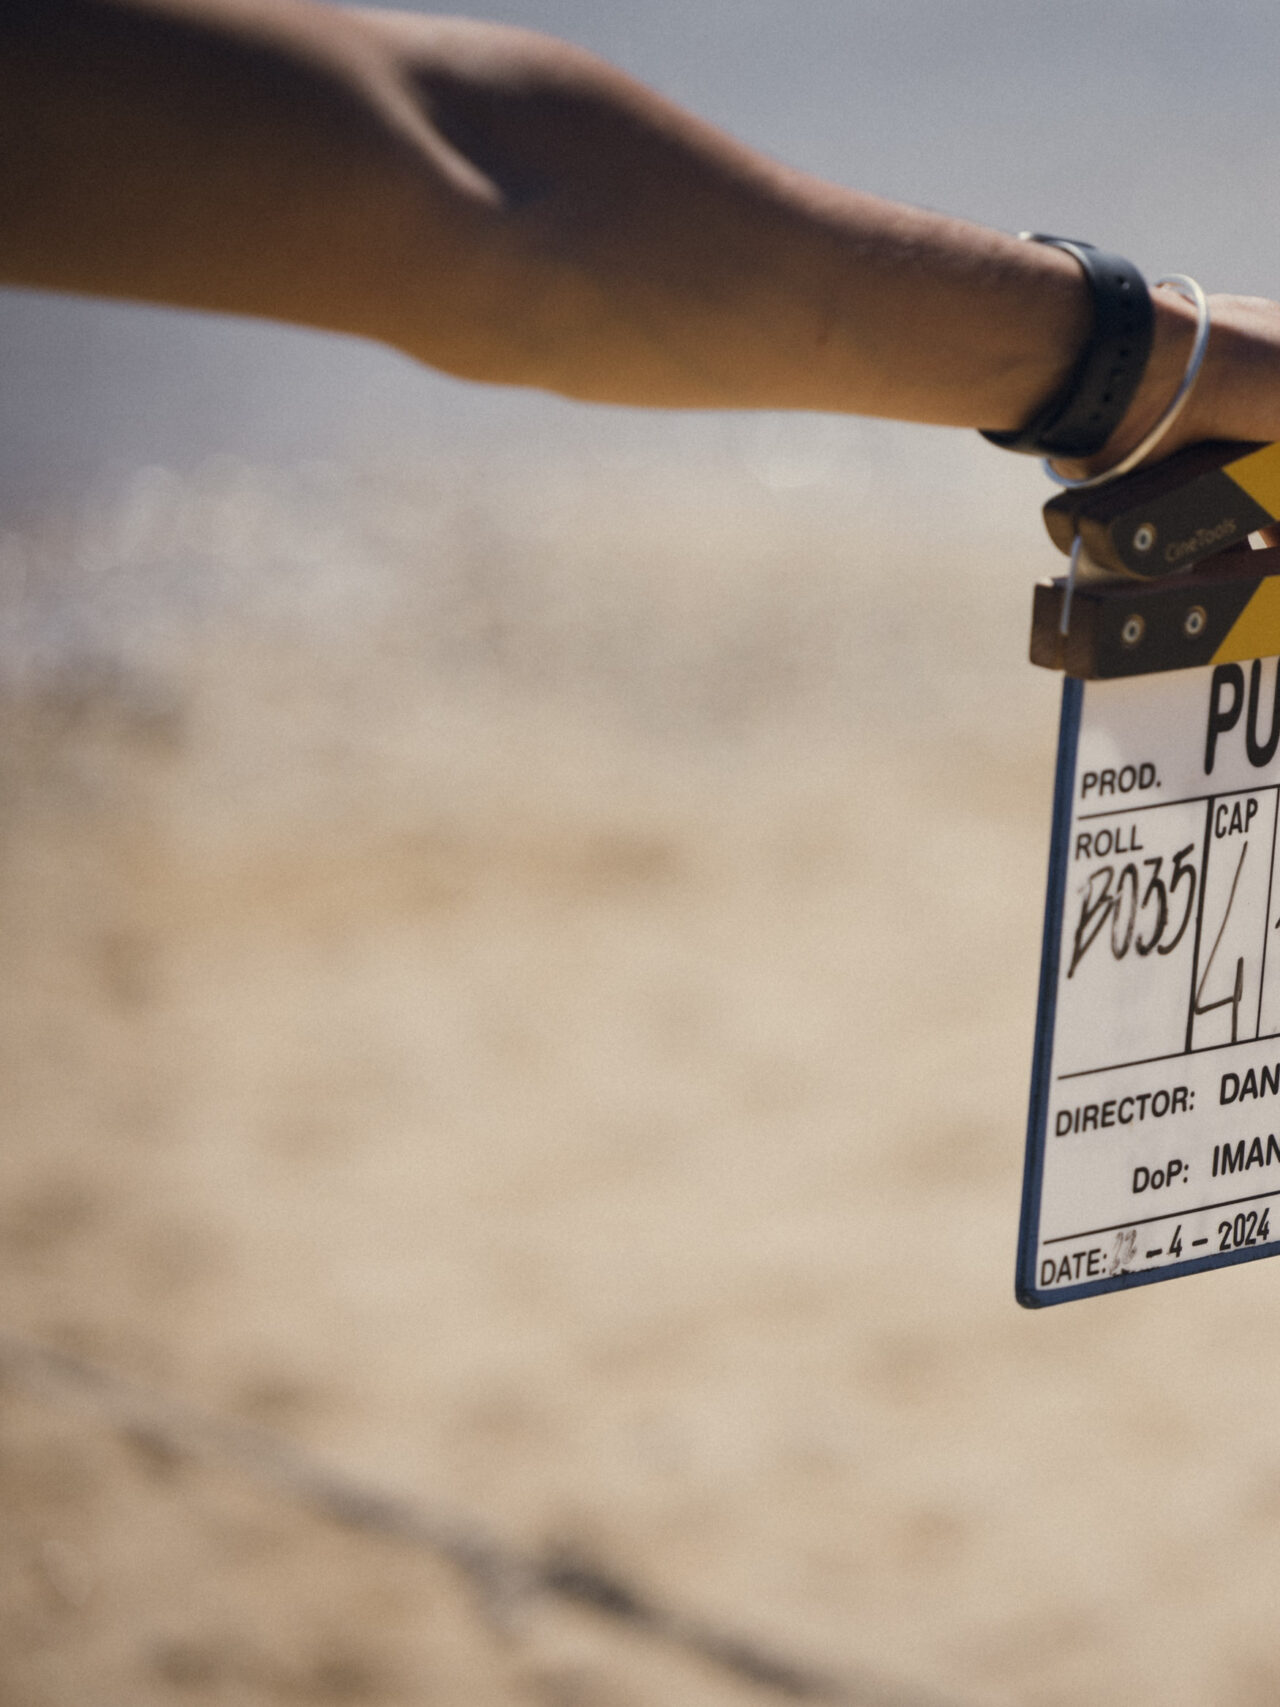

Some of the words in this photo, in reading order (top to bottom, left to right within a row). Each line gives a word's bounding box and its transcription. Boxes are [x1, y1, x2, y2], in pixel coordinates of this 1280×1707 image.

[1165, 518, 1237, 563] CineTools
[1081, 763, 1162, 799] PROD.
[1214, 798, 1259, 839] CAP
[1075, 825, 1143, 861] ROLL
[1067, 843, 1197, 979] B035
[1194, 840, 1249, 1045] 4
[1055, 1086, 1196, 1137] DIRECTOR:
[1132, 1159, 1189, 1194] DoP:
[1040, 1248, 1108, 1287] DATE:
[1168, 1224, 1183, 1258] 4
[1218, 1207, 1271, 1252] 2024
